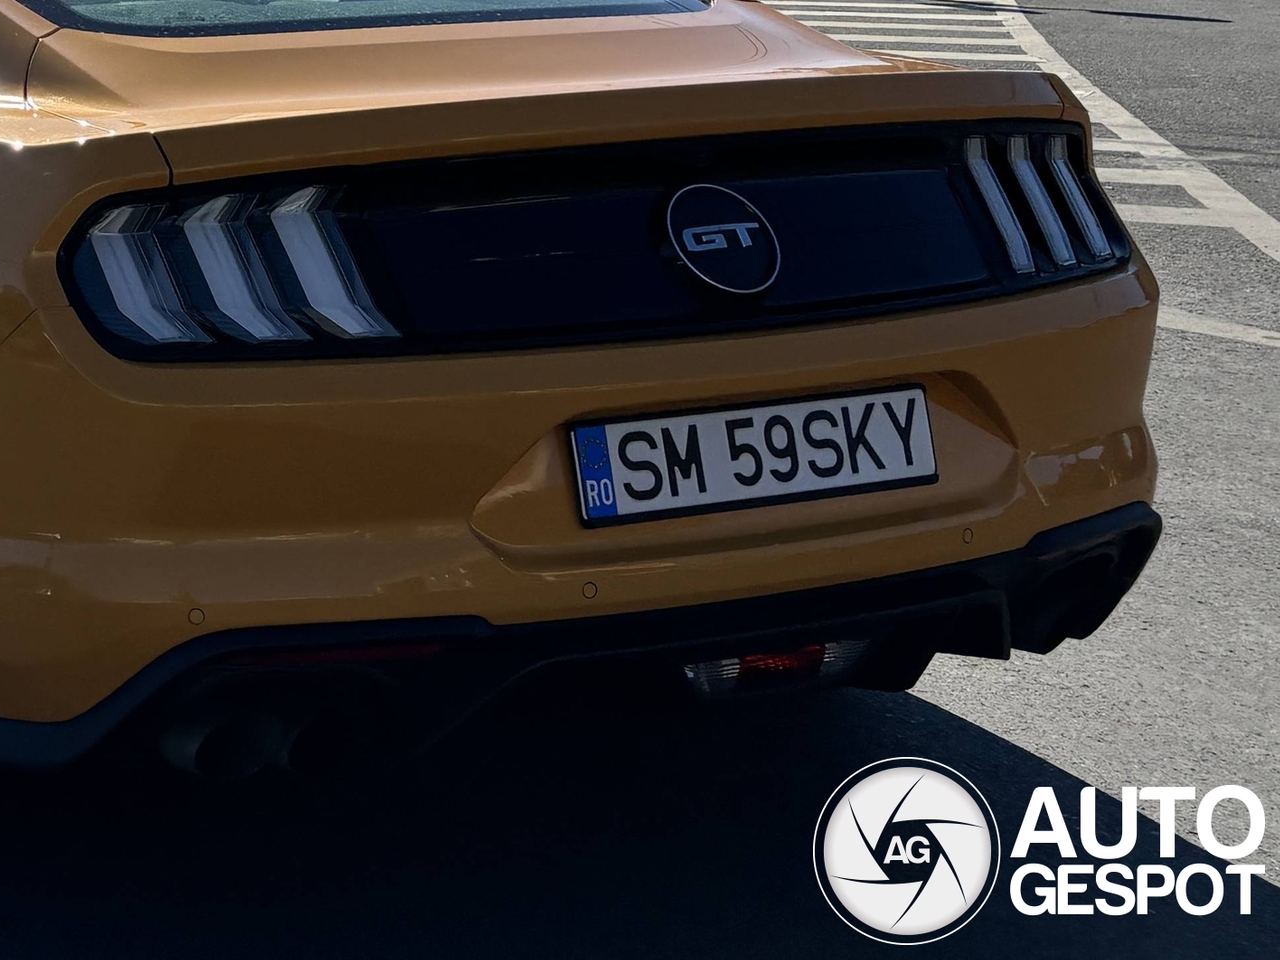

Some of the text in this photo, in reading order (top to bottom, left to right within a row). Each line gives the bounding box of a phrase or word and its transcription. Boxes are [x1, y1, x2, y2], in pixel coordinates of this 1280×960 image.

[682, 222, 759, 251] GT
[617, 424, 707, 501] SM
[586, 478, 614, 508] RO
